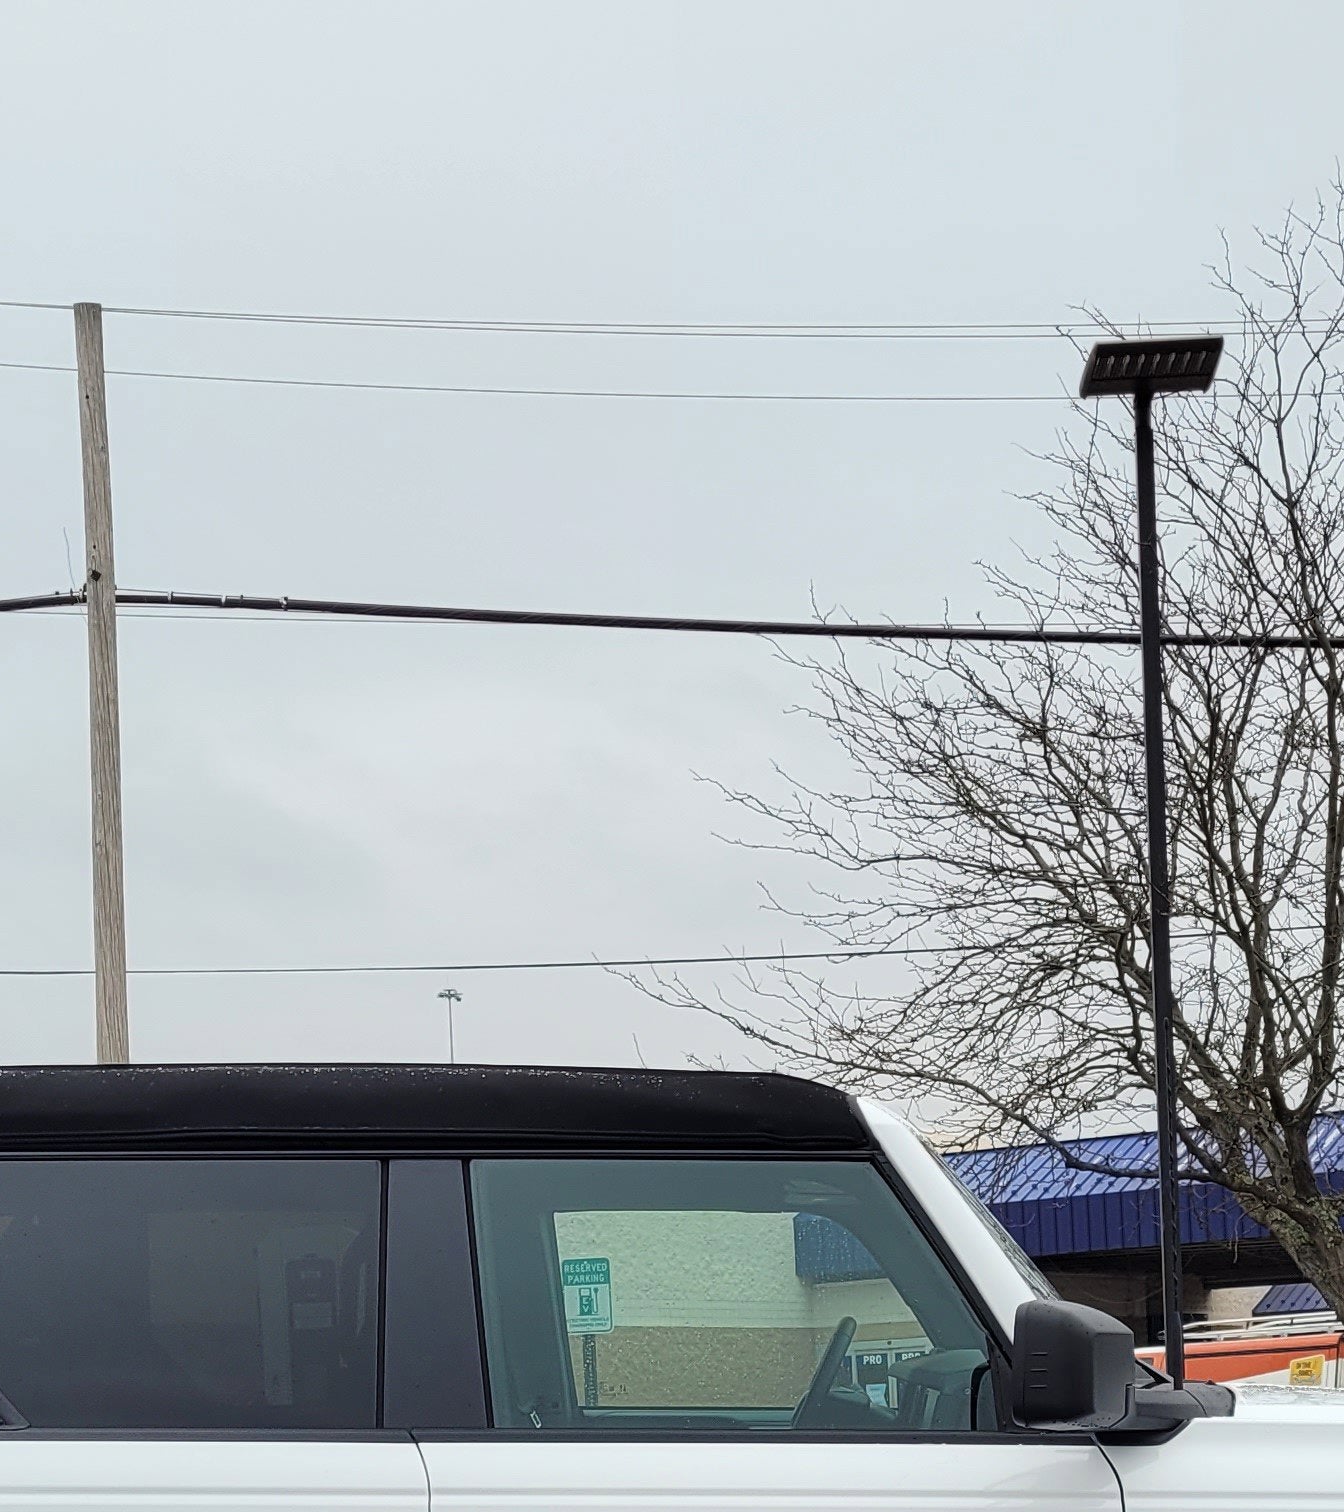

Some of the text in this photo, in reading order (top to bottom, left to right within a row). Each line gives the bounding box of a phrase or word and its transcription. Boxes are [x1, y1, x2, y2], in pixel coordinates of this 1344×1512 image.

[563, 1263, 607, 1273] RESERVED
[567, 1273, 605, 1284] PARKING
[863, 1355, 882, 1365] PRO
